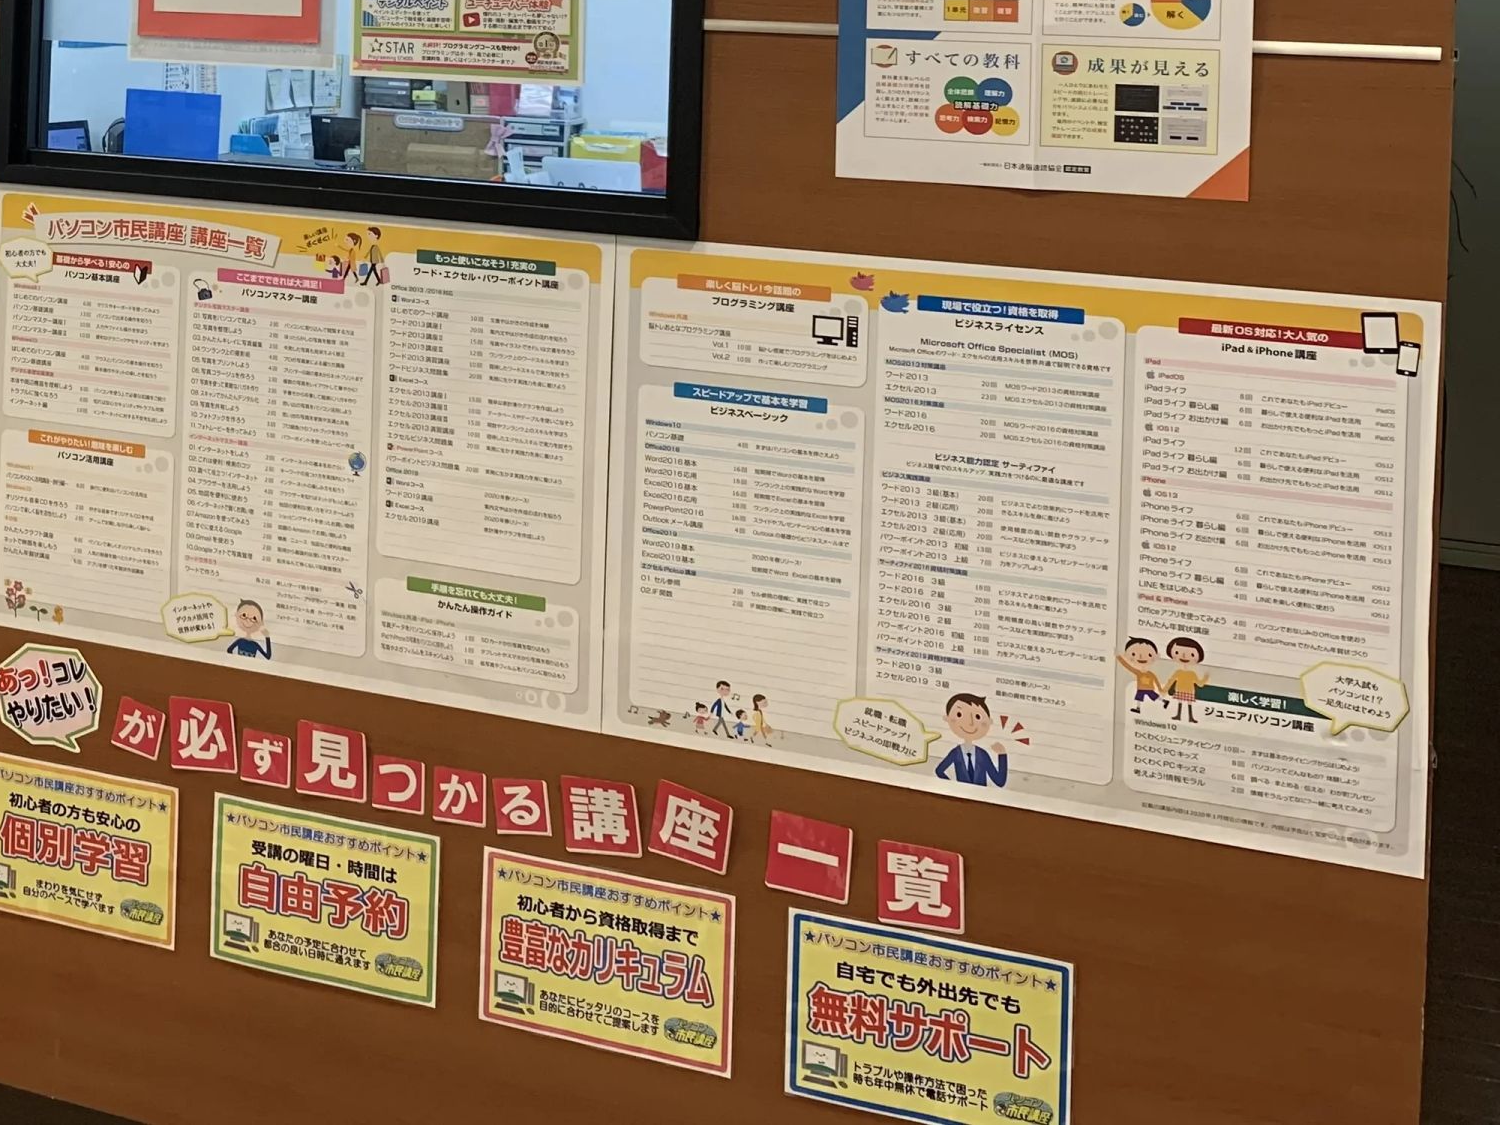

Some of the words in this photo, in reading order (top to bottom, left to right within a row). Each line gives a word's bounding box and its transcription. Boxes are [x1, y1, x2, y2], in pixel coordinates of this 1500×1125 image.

[1165, 9, 1185, 21] 解く
[385, 42, 415, 54] STAR
[905, 49, 1021, 71] すべての教科
[1087, 57, 1211, 78] 成果が見える
[47, 218, 186, 248] パソコン市民講座
[189, 227, 267, 257] 講座一覧
[65, 271, 121, 284] パソコン基本講座
[241, 289, 318, 304] パソコンマスター講座
[712, 297, 795, 313] プログラミング講座
[942, 300, 1059, 320] 現場で役立つ!資格を取得
[955, 318, 1045, 336] ビジネスライセンス
[1211, 323, 1329, 343] 最新OS対応!大人気の
[920, 338, 965, 350] Microsoft
[968, 342, 996, 352] Office
[999, 345, 1046, 357] Specialist
[1049, 350, 1079, 361] (MOS)
[1221, 343, 1245, 354] iPad
[1256, 345, 1293, 358] iPhone
[1295, 349, 1317, 361] 講座
[692, 387, 808, 410] スピードアップで基本を学習
[710, 406, 789, 423] ビジネスベーシック
[57, 451, 114, 467] パソコン活用講座
[438, 600, 513, 619] かんたん操作ガイド
[1335, 675, 1379, 692] 大学入試も
[1204, 706, 1315, 733] ジュニアパソコン講座
[9, 792, 141, 832] 初心者の方も安心の
[0, 813, 149, 885] 個別学習
[251, 840, 398, 884] 受講の曜日・時間は
[23, 886, 115, 914] 自分のペースで学べます
[36, 879, 103, 902] まわりを気にせず
[239, 862, 409, 939] 自由予約
[517, 894, 699, 946] 初心者から資格取得まで
[264, 940, 370, 971] 都合の良い日時に通えます
[267, 929, 366, 959] あなたの予定に合わせて
[501, 917, 714, 1007] 豊富なカリキュラム
[836, 961, 1021, 1014] 自宅でも外出先でも
[539, 989, 659, 1025] あなたにピッタリのコースを
[539, 1000, 659, 1036] 目的に合わせてご提案します
[808, 984, 1050, 1078] 無料サポート
[853, 1061, 988, 1100] トラブルや操作方法で困った
[853, 1073, 989, 1112] 時も年中無休で電話サポート
